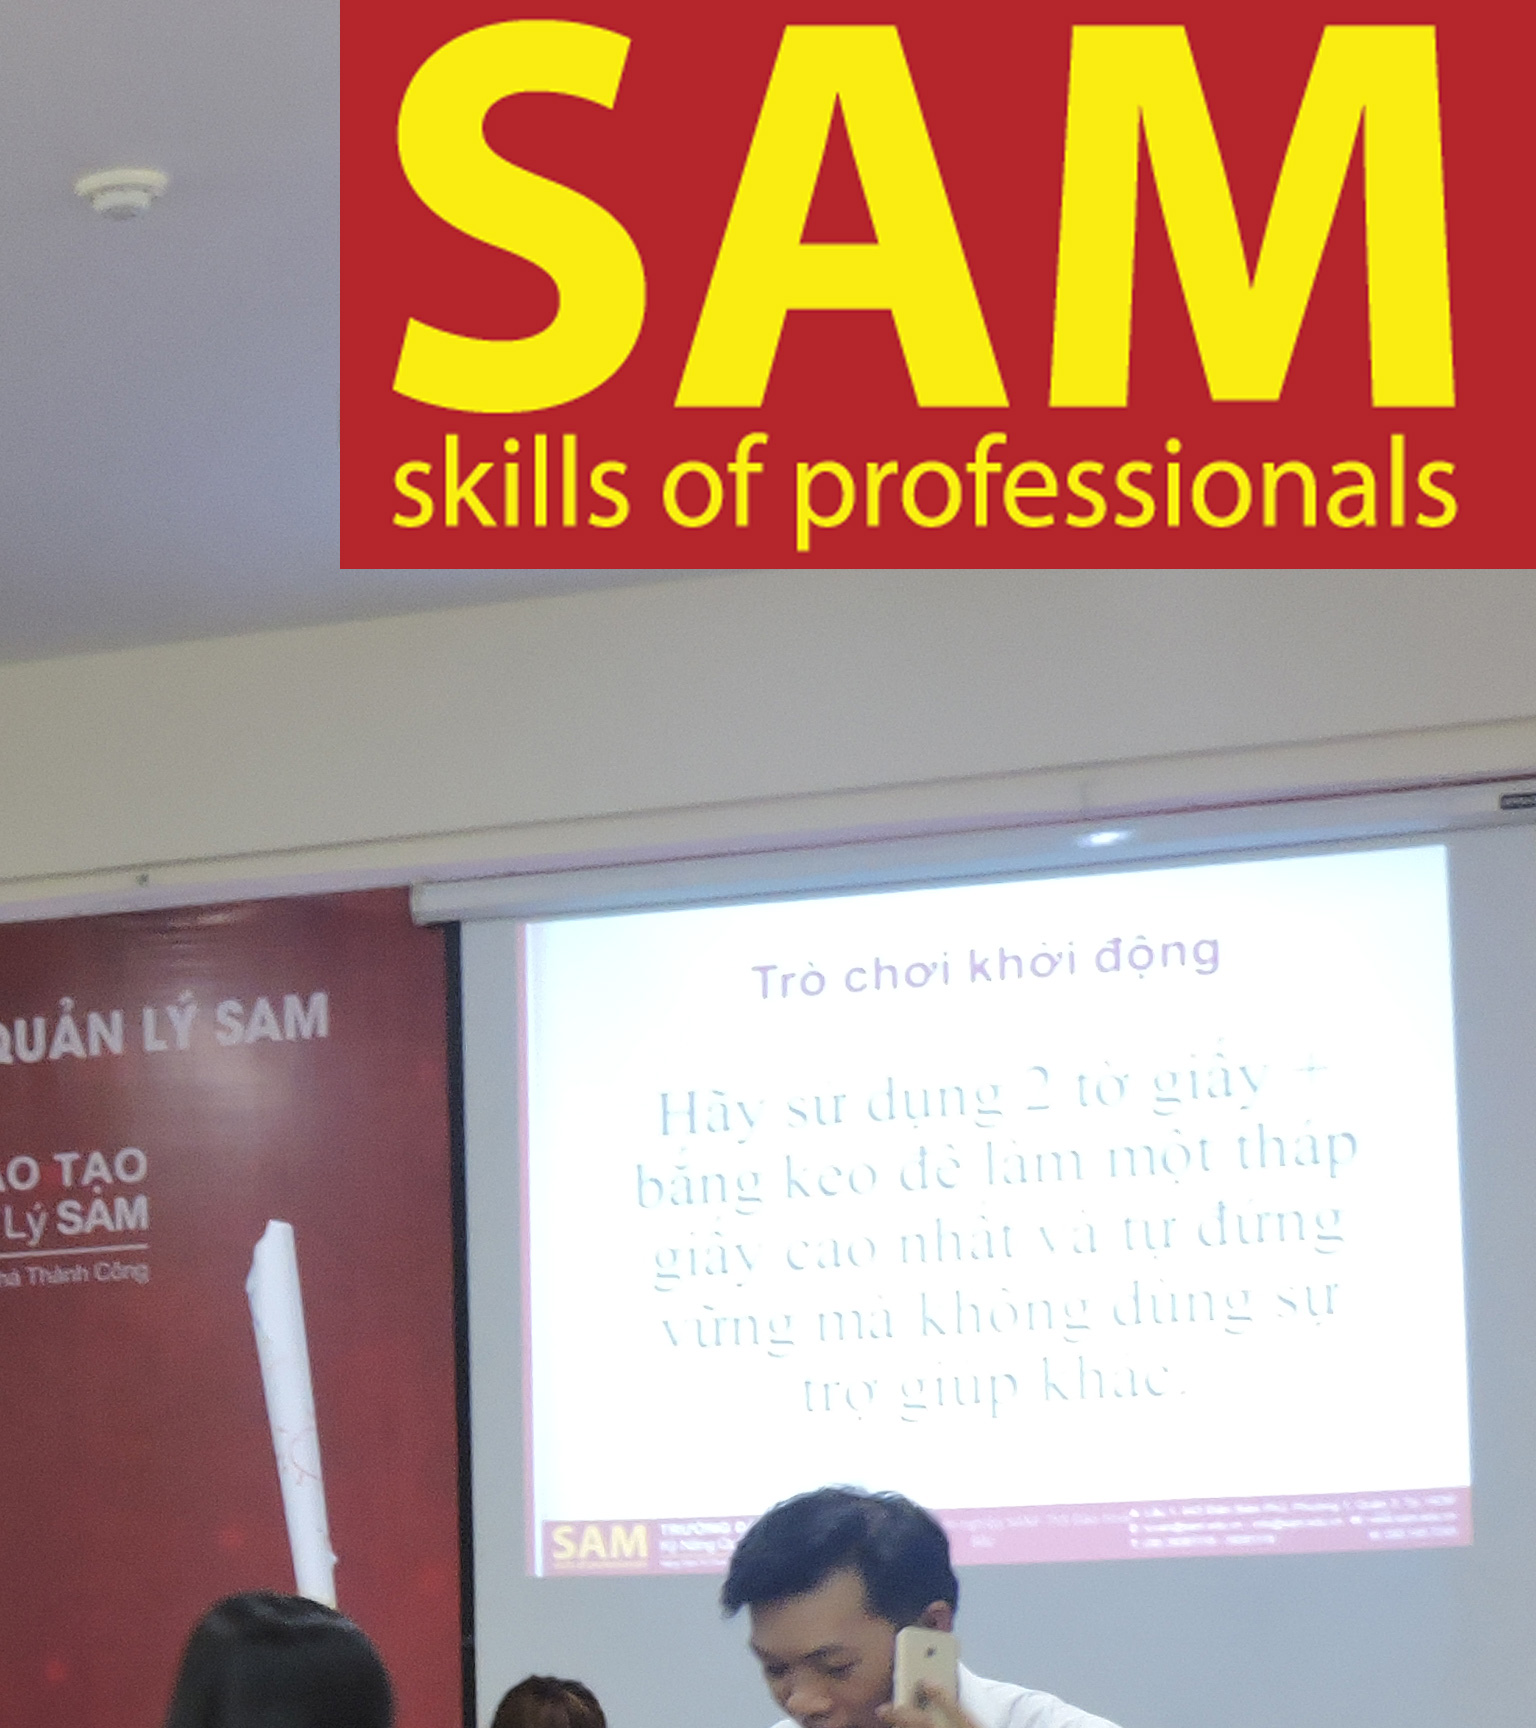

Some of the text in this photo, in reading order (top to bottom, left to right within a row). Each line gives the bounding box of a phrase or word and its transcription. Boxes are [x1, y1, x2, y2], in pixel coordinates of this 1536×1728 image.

[751, 961, 826, 1000] Trò
[844, 951, 950, 994] chơi
[1094, 935, 1221, 981] động
[142, 990, 197, 1052] LÝ
[215, 992, 328, 1046] SAM
[867, 1075, 1003, 1129] dụng
[1028, 1066, 1050, 1110] 2
[1078, 1060, 1129, 1107] tờ
[54, 1147, 148, 1193] TẠO
[986, 1139, 1083, 1186] làm
[1109, 1129, 1210, 1184] một
[4, 1202, 47, 1246] Lý
[57, 1195, 149, 1236] SAM
[787, 1237, 875, 1271] cao
[1125, 1216, 1177, 1260] tự
[552, 1524, 648, 1559] SAM
